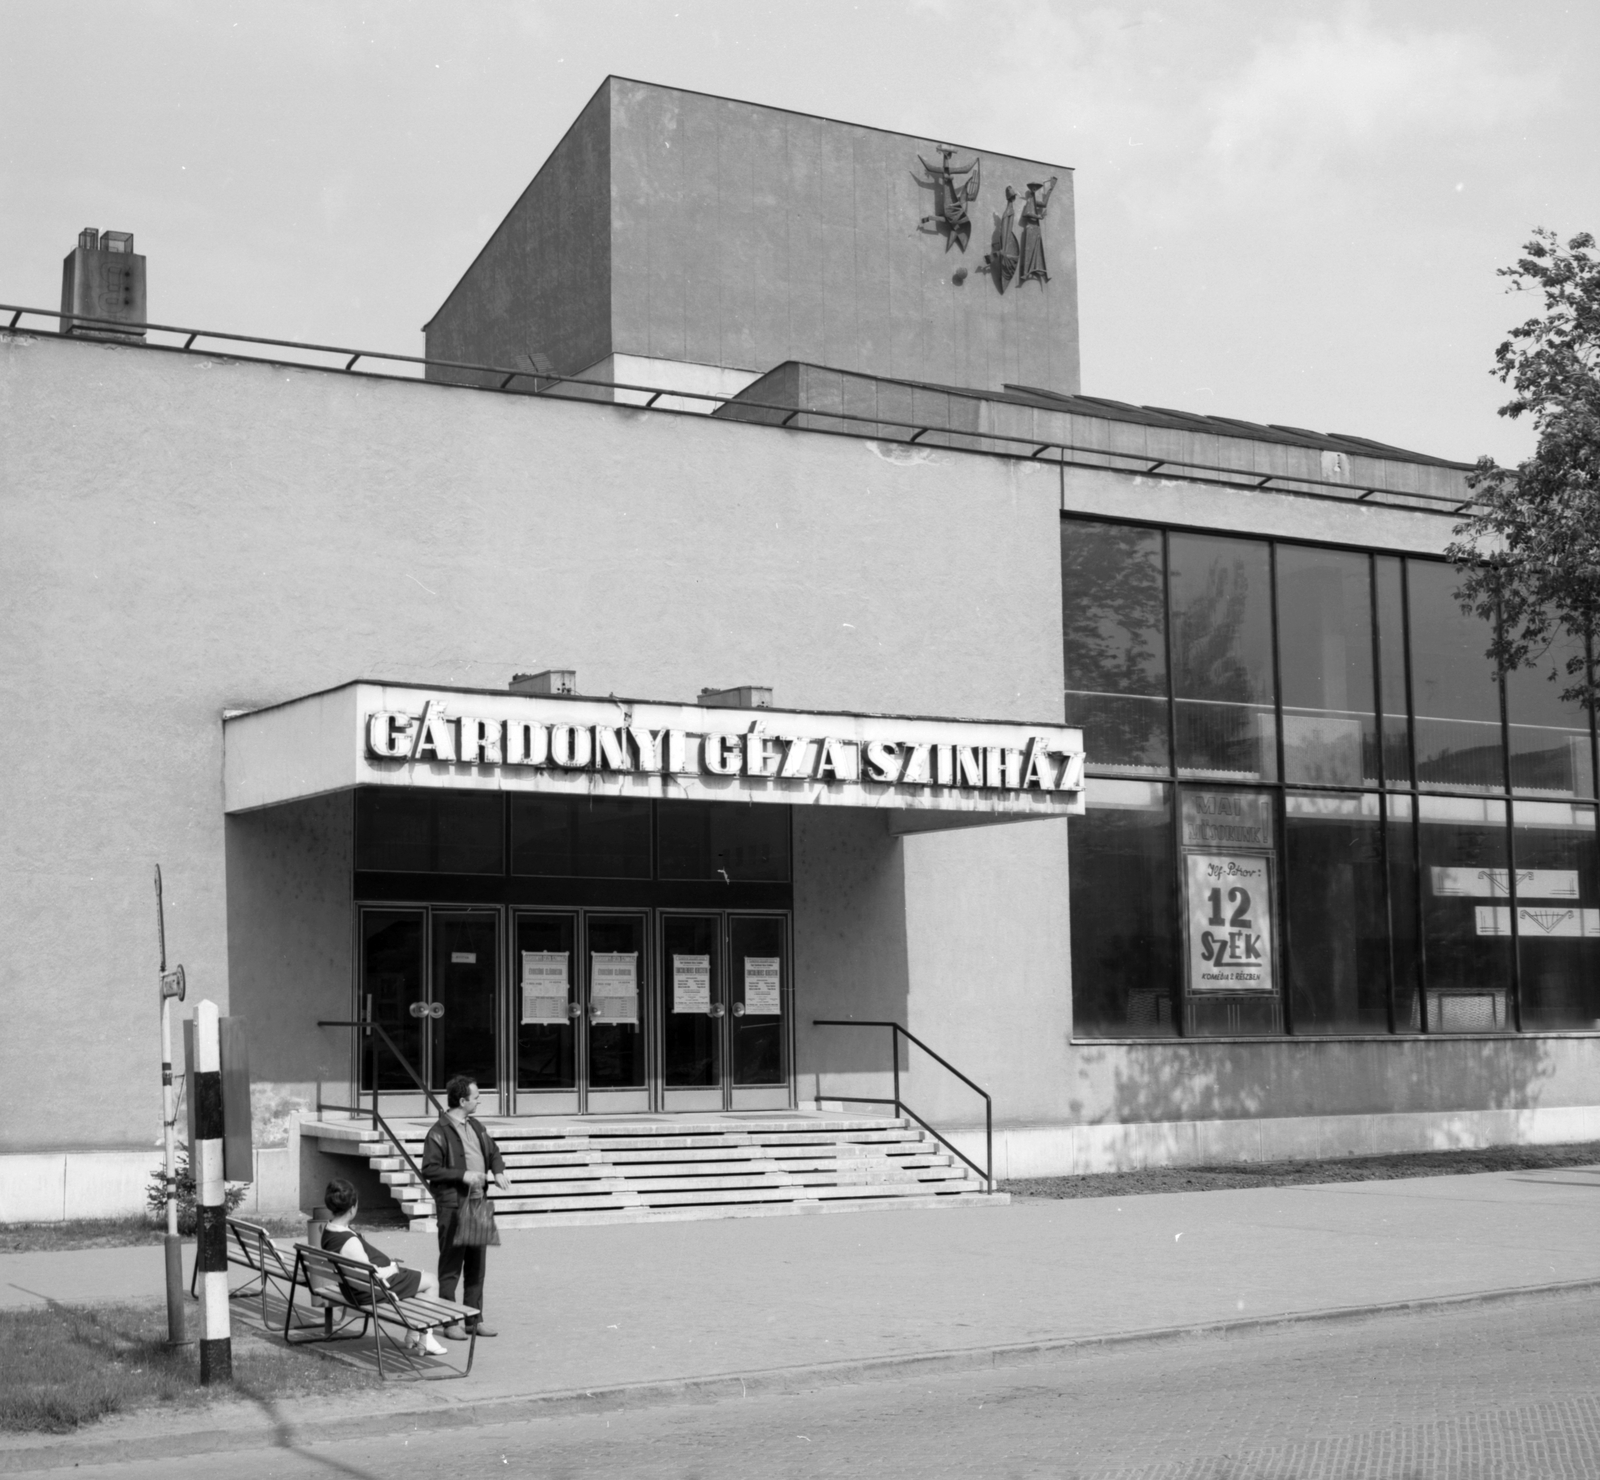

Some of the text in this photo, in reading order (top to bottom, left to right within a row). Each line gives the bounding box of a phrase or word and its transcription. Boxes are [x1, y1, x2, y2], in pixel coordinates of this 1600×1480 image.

[364, 700, 1087, 792] GÁRDONYI GÉZA SZINHÁZ
[1195, 796, 1241, 816] MAI
[1208, 886, 1252, 929] 12
[1201, 930, 1262, 967] SZÉK
[1235, 970, 1261, 981] RÉSZBEN
